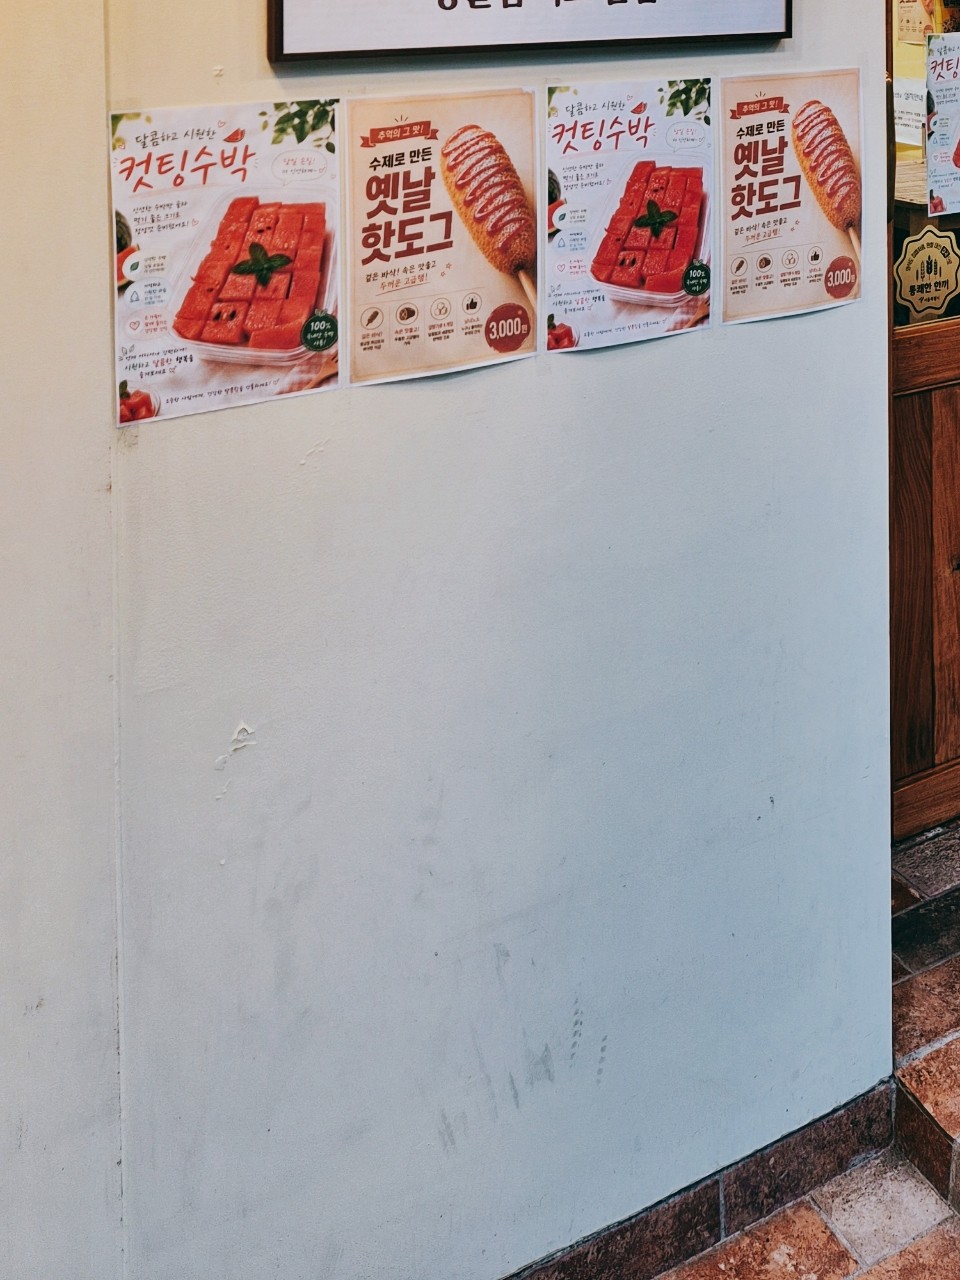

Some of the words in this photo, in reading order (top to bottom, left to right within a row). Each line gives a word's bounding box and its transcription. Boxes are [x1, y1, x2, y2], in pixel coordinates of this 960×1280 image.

[565, 101, 598, 117] 달콤하고
[602, 100, 626, 111] 시원한
[135, 130, 179, 149] 달콤하고
[183, 128, 217, 141] 시원한
[378, 128, 401, 140] 추억의
[402, 127, 410, 137] 그
[412, 124, 424, 135] 맛!
[552, 116, 655, 155] 컷팅수박
[736, 123, 764, 140] 수제로
[766, 119, 785, 134] 만든
[118, 144, 256, 193] 컷팅수박
[369, 152, 406, 172] 수제로
[409, 146, 433, 164] 만든
[734, 136, 788, 181] 옛날
[365, 166, 436, 221] 옛날
[731, 175, 801, 221] 핫도그
[361, 211, 454, 266] 핫도그
[311, 321, 331, 331] 100%
